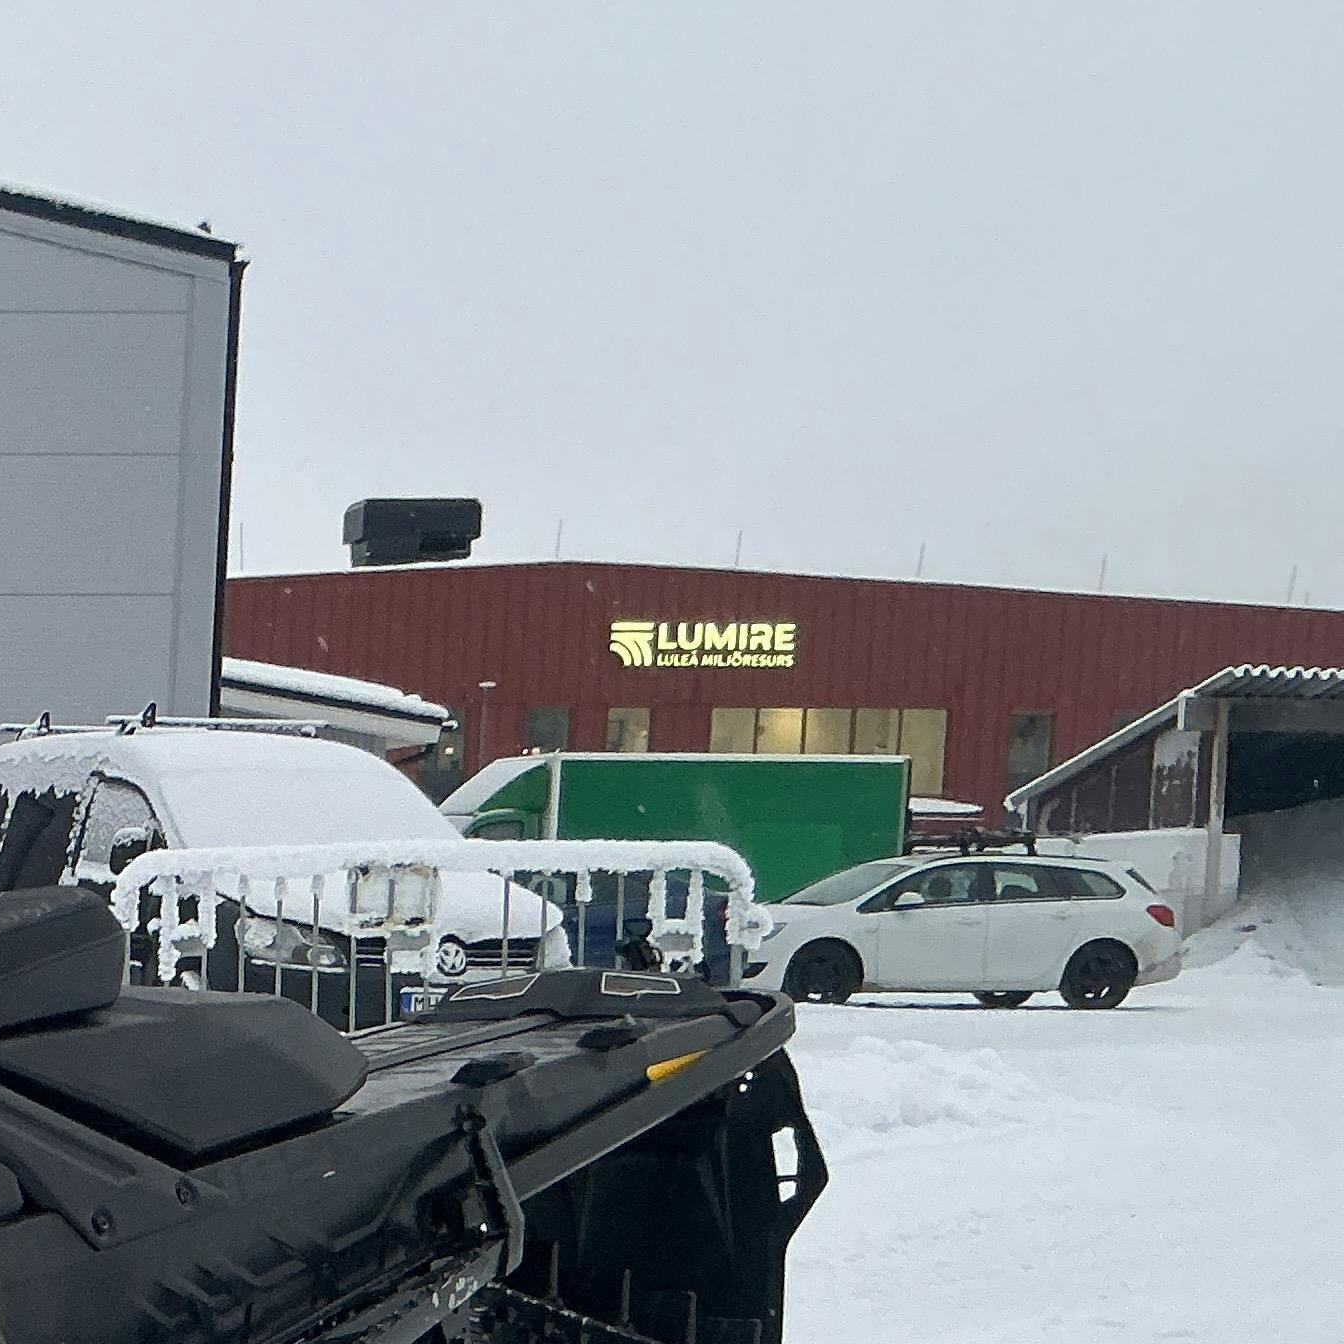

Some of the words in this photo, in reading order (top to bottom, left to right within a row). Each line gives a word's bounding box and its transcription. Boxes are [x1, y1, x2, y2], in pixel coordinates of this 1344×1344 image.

[657, 622, 797, 651] LUMIRE
[657, 650, 699, 667] LULEÅ
[700, 650, 795, 668] MILJÖRESURS
